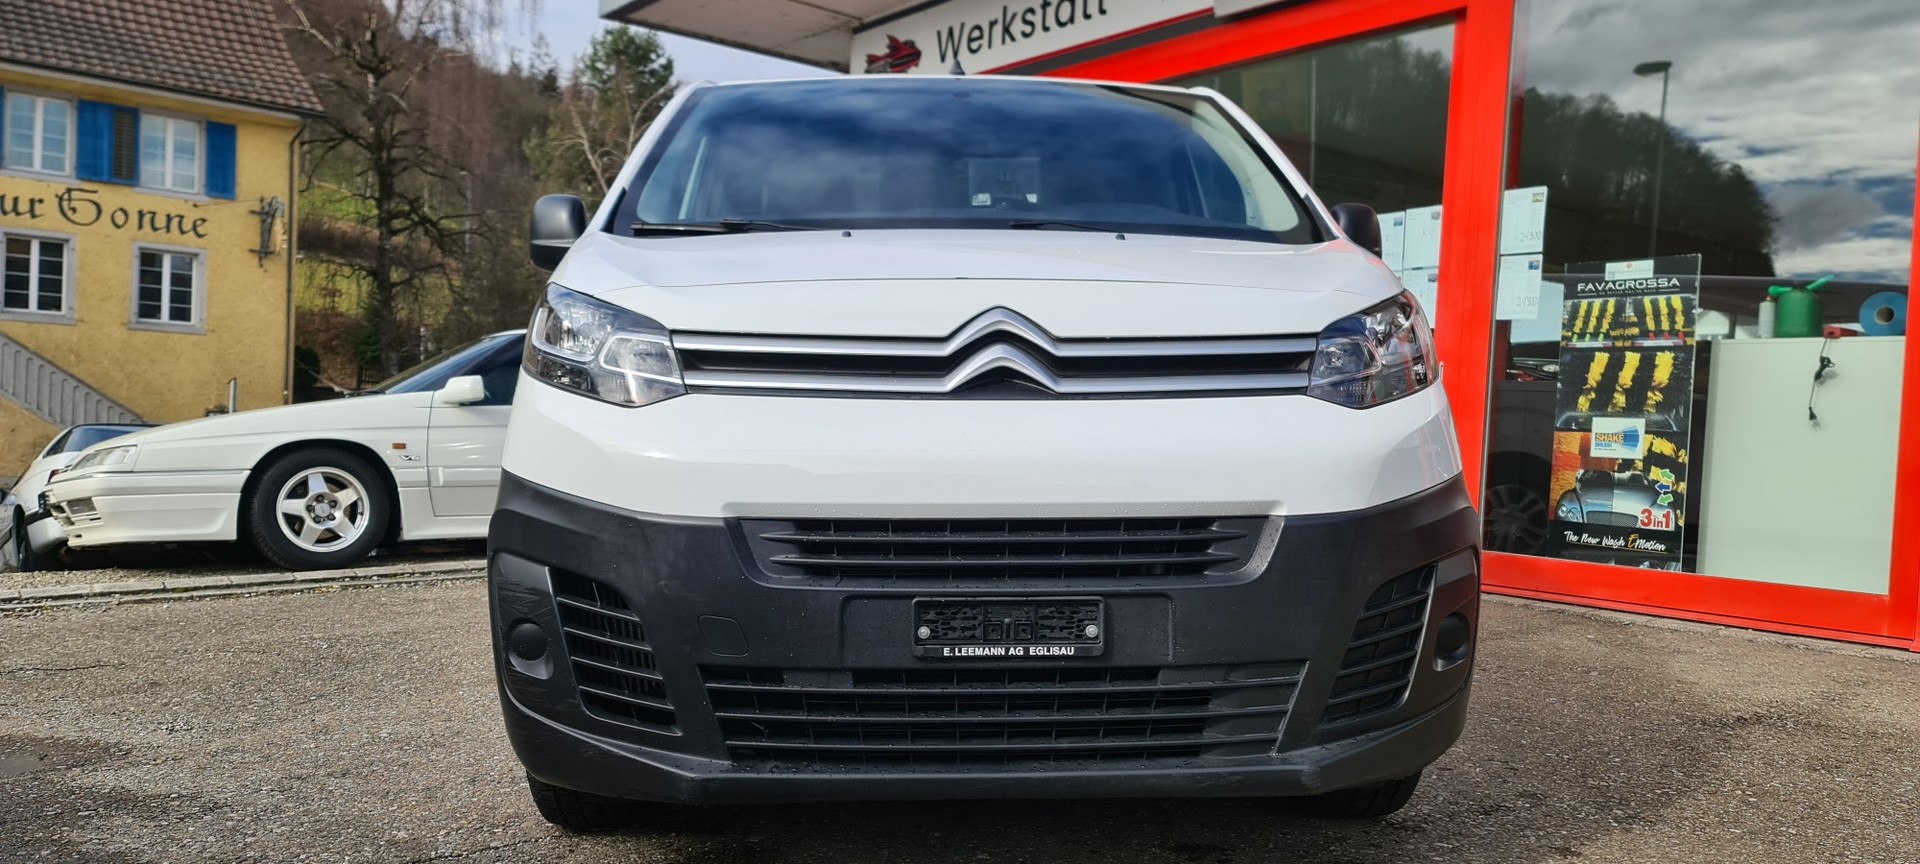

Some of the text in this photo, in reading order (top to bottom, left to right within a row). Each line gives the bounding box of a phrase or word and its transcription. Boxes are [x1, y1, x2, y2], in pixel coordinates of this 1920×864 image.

[55, 187, 208, 239] Sonne
[1577, 277, 1680, 292] FAVAGROSSA
[1595, 433, 1624, 443] SHAKE
[1564, 531, 1580, 542] The
[1581, 533, 1600, 543] New
[1602, 535, 1625, 549] Wash
[943, 646, 1075, 656] E. LEEMANN AG EGLISAU
